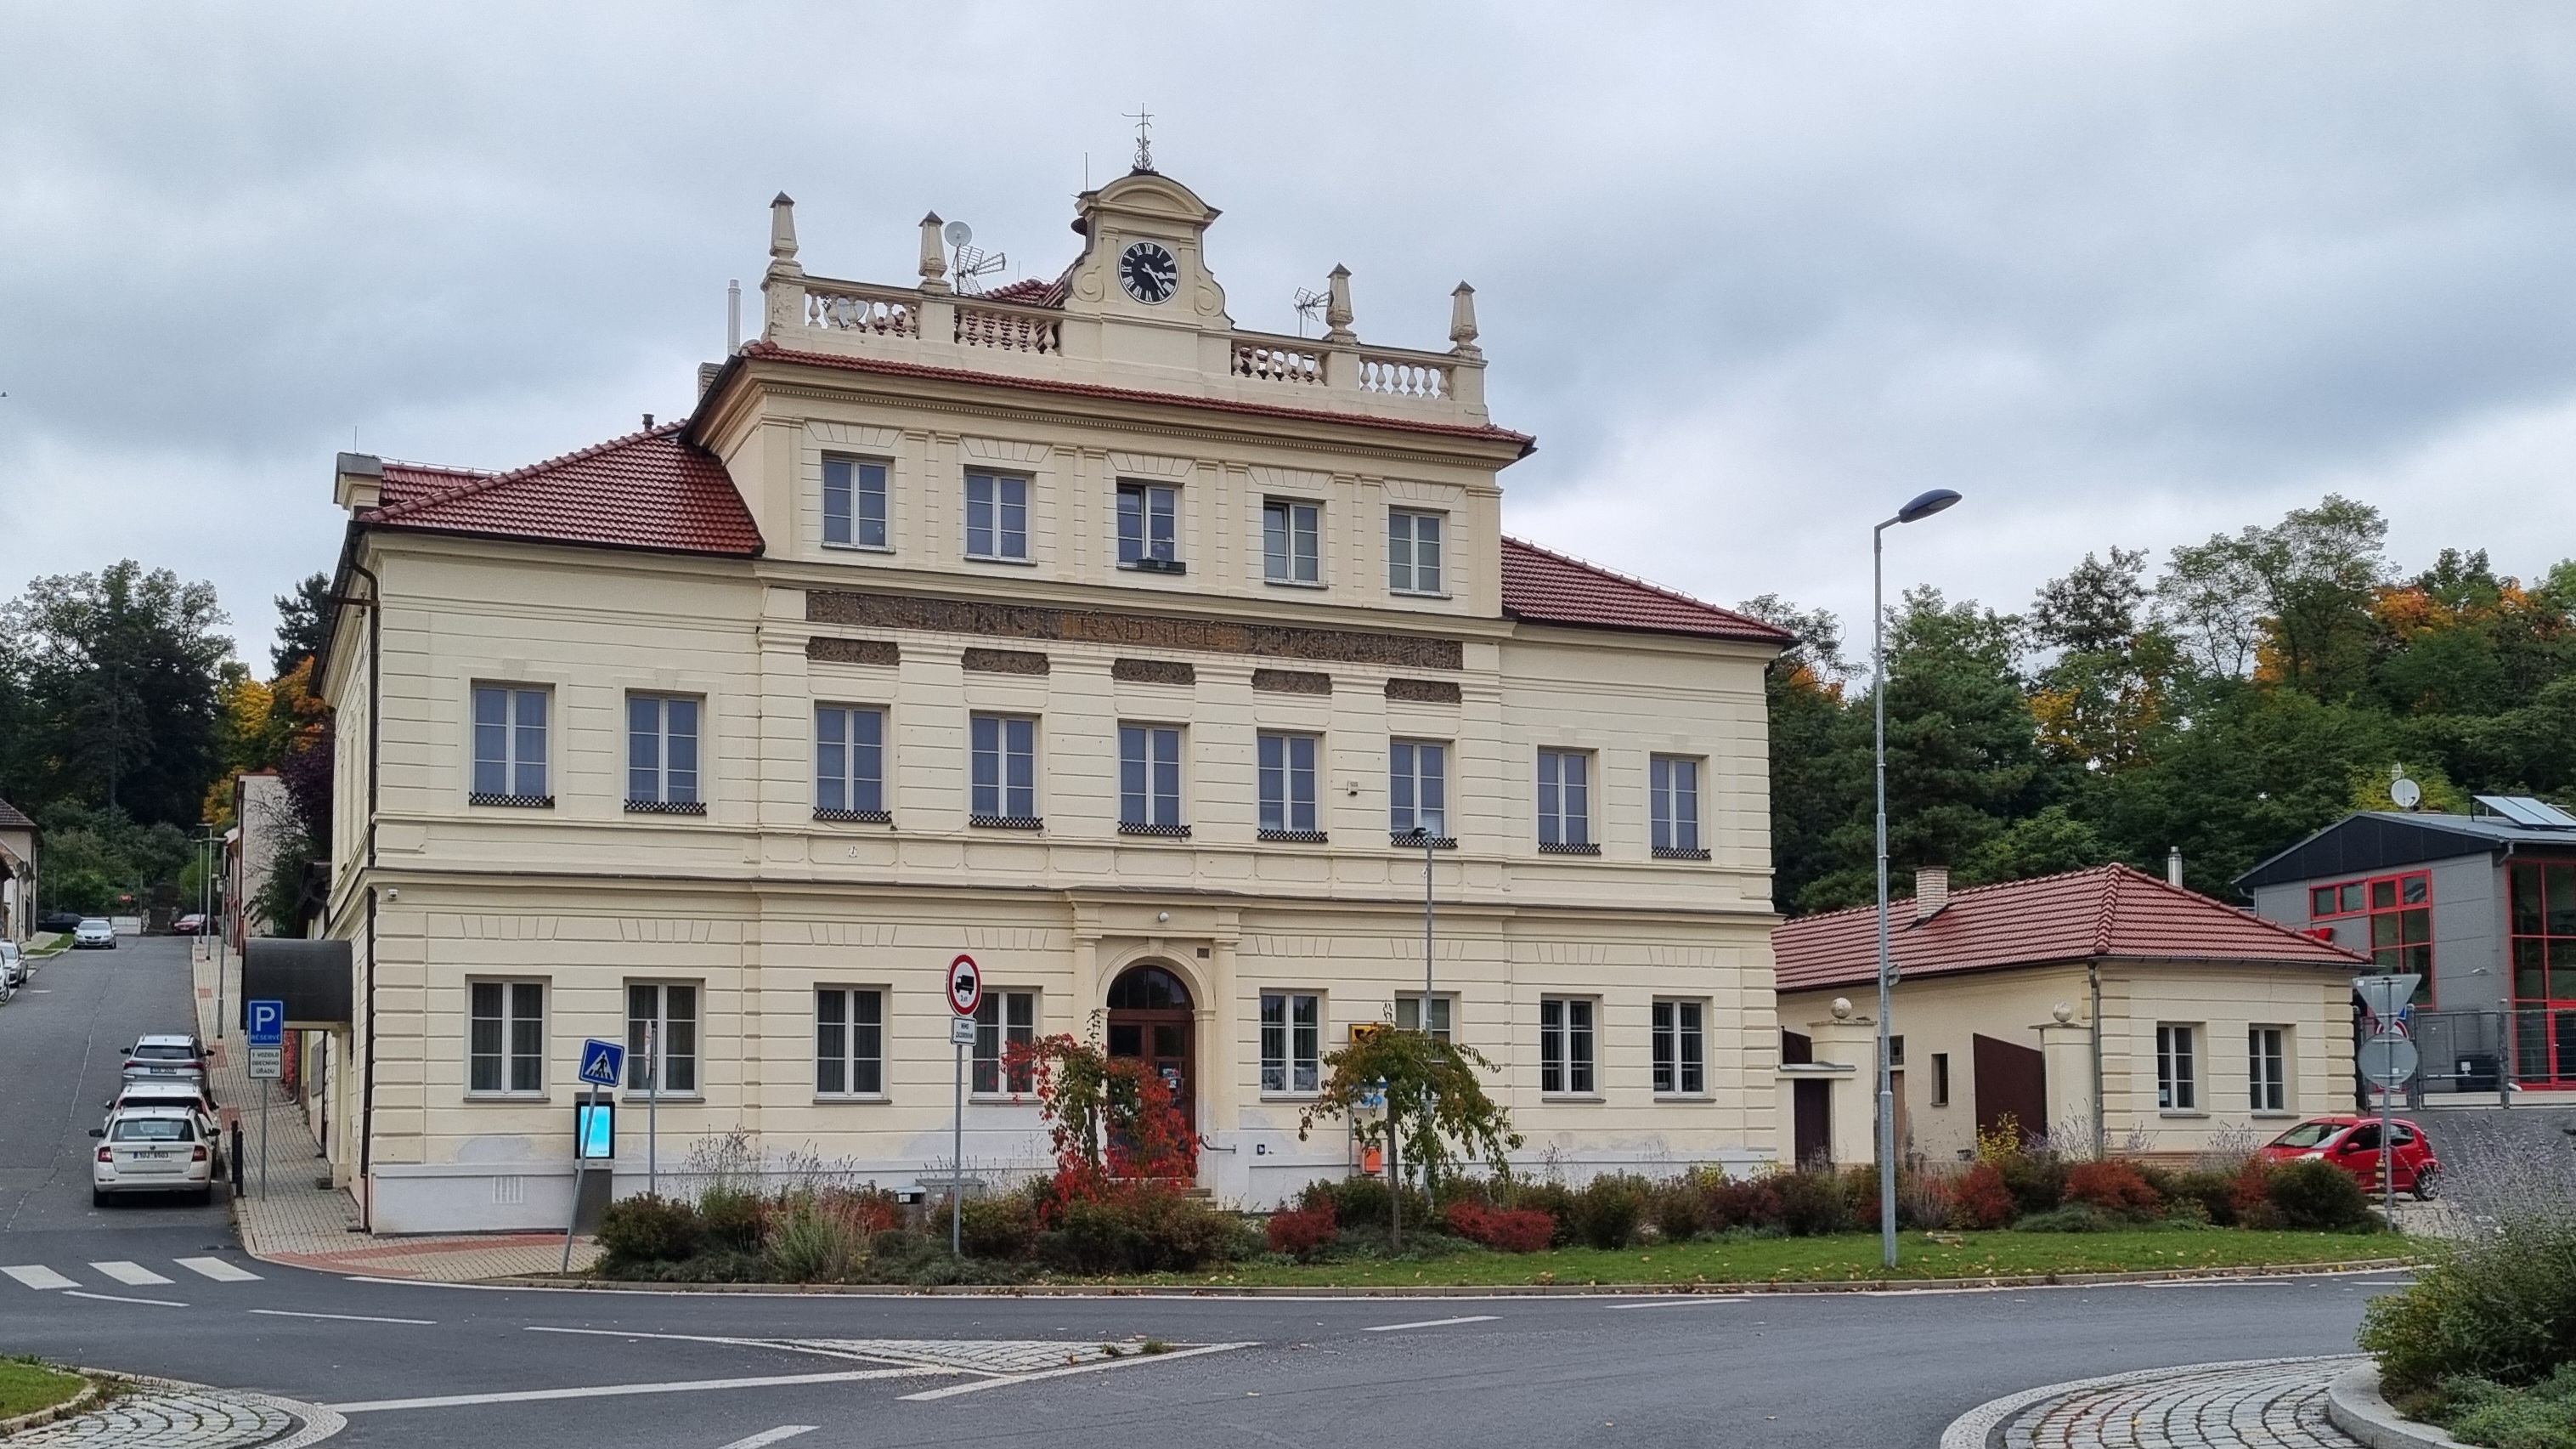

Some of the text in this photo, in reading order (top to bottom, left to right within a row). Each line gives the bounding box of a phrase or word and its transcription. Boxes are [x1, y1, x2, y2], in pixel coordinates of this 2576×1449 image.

[1156, 249, 1164, 258] I
[1079, 617, 1222, 646] RADNICE
[257, 1006, 275, 1031] P
